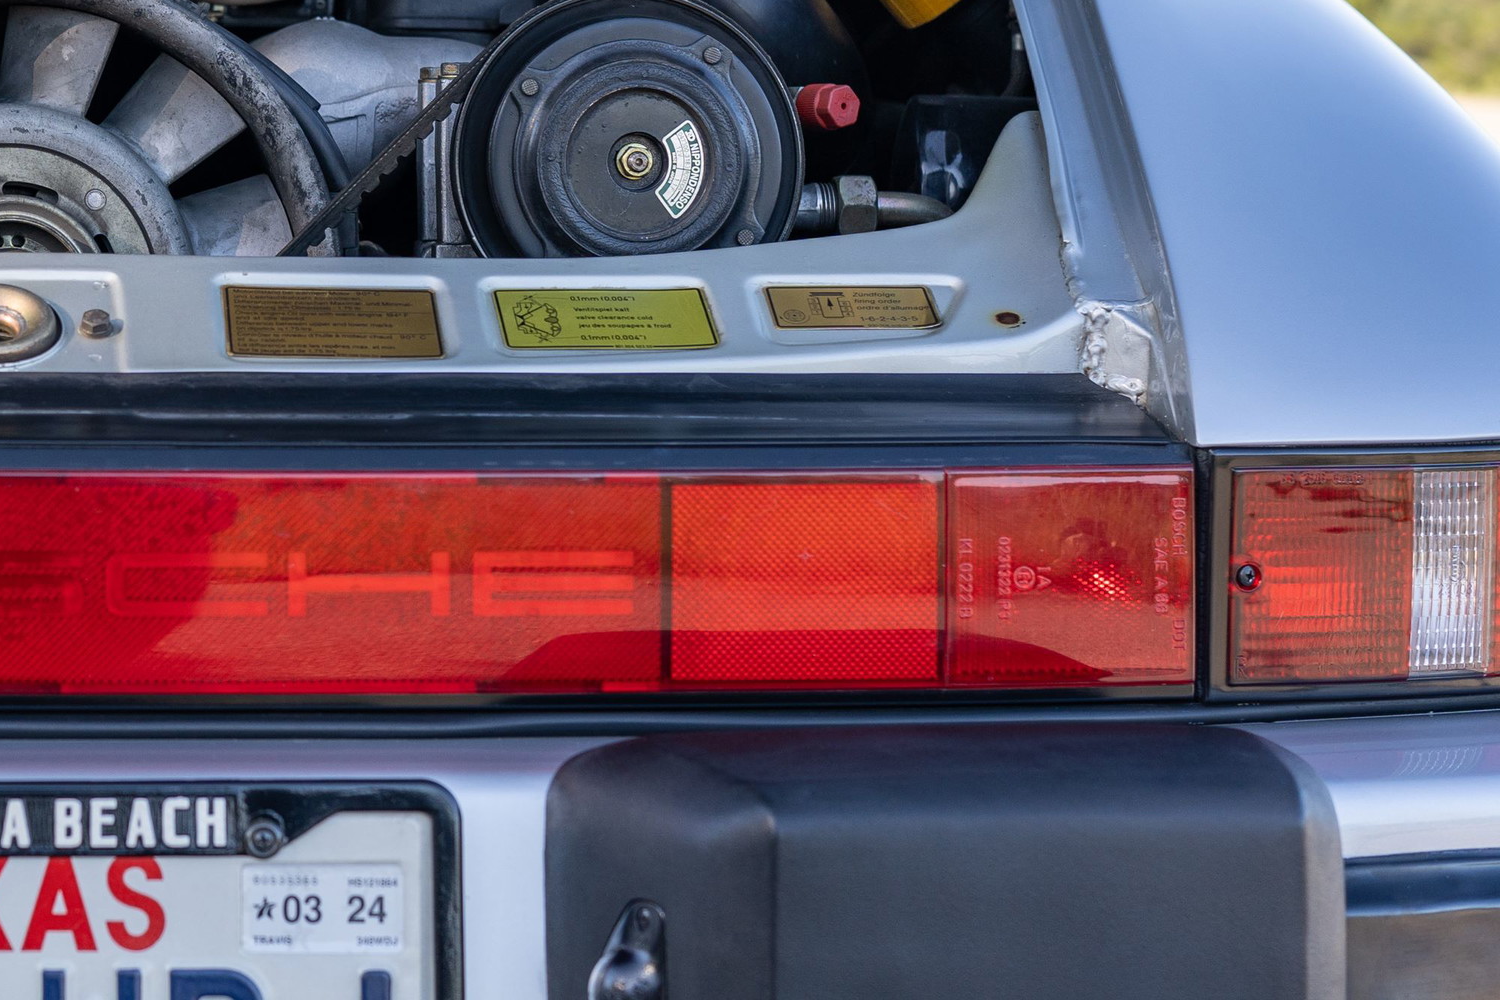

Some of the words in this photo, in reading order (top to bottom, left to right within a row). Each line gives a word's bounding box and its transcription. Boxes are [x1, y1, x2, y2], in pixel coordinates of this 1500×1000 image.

[675, 143, 701, 209] NIPPONDENSO
[1172, 497, 1187, 557] BOSCH
[1154, 537, 1169, 572] SAE
[1154, 580, 1168, 591] A
[1172, 619, 1186, 651] DOT
[53, 796, 229, 849] BEACH
[282, 895, 322, 924] 03
[347, 895, 387, 924] 24
